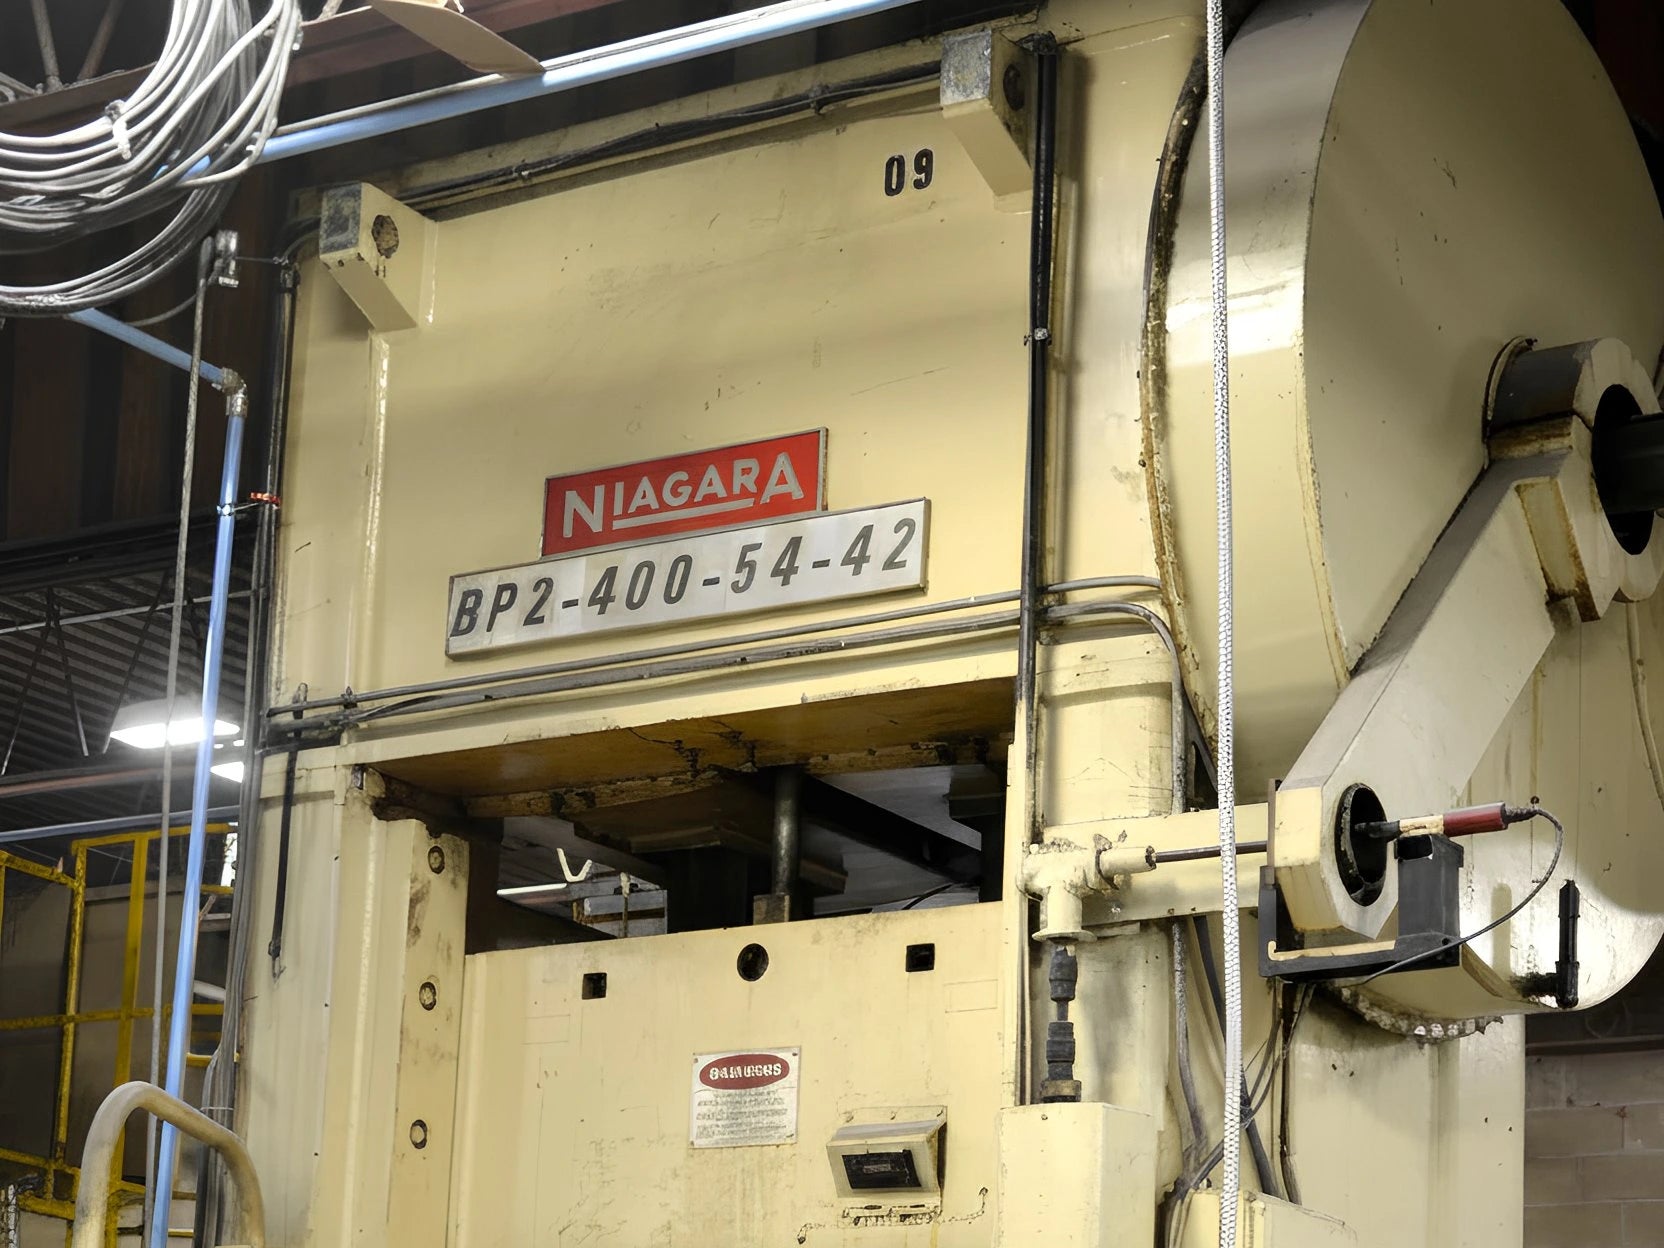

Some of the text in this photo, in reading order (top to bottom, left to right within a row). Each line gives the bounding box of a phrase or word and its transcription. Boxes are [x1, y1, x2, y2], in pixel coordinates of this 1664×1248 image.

[884, 148, 934, 197] 09
[563, 451, 804, 538] NIAGARA
[450, 517, 916, 638] BP2-400-54-42
